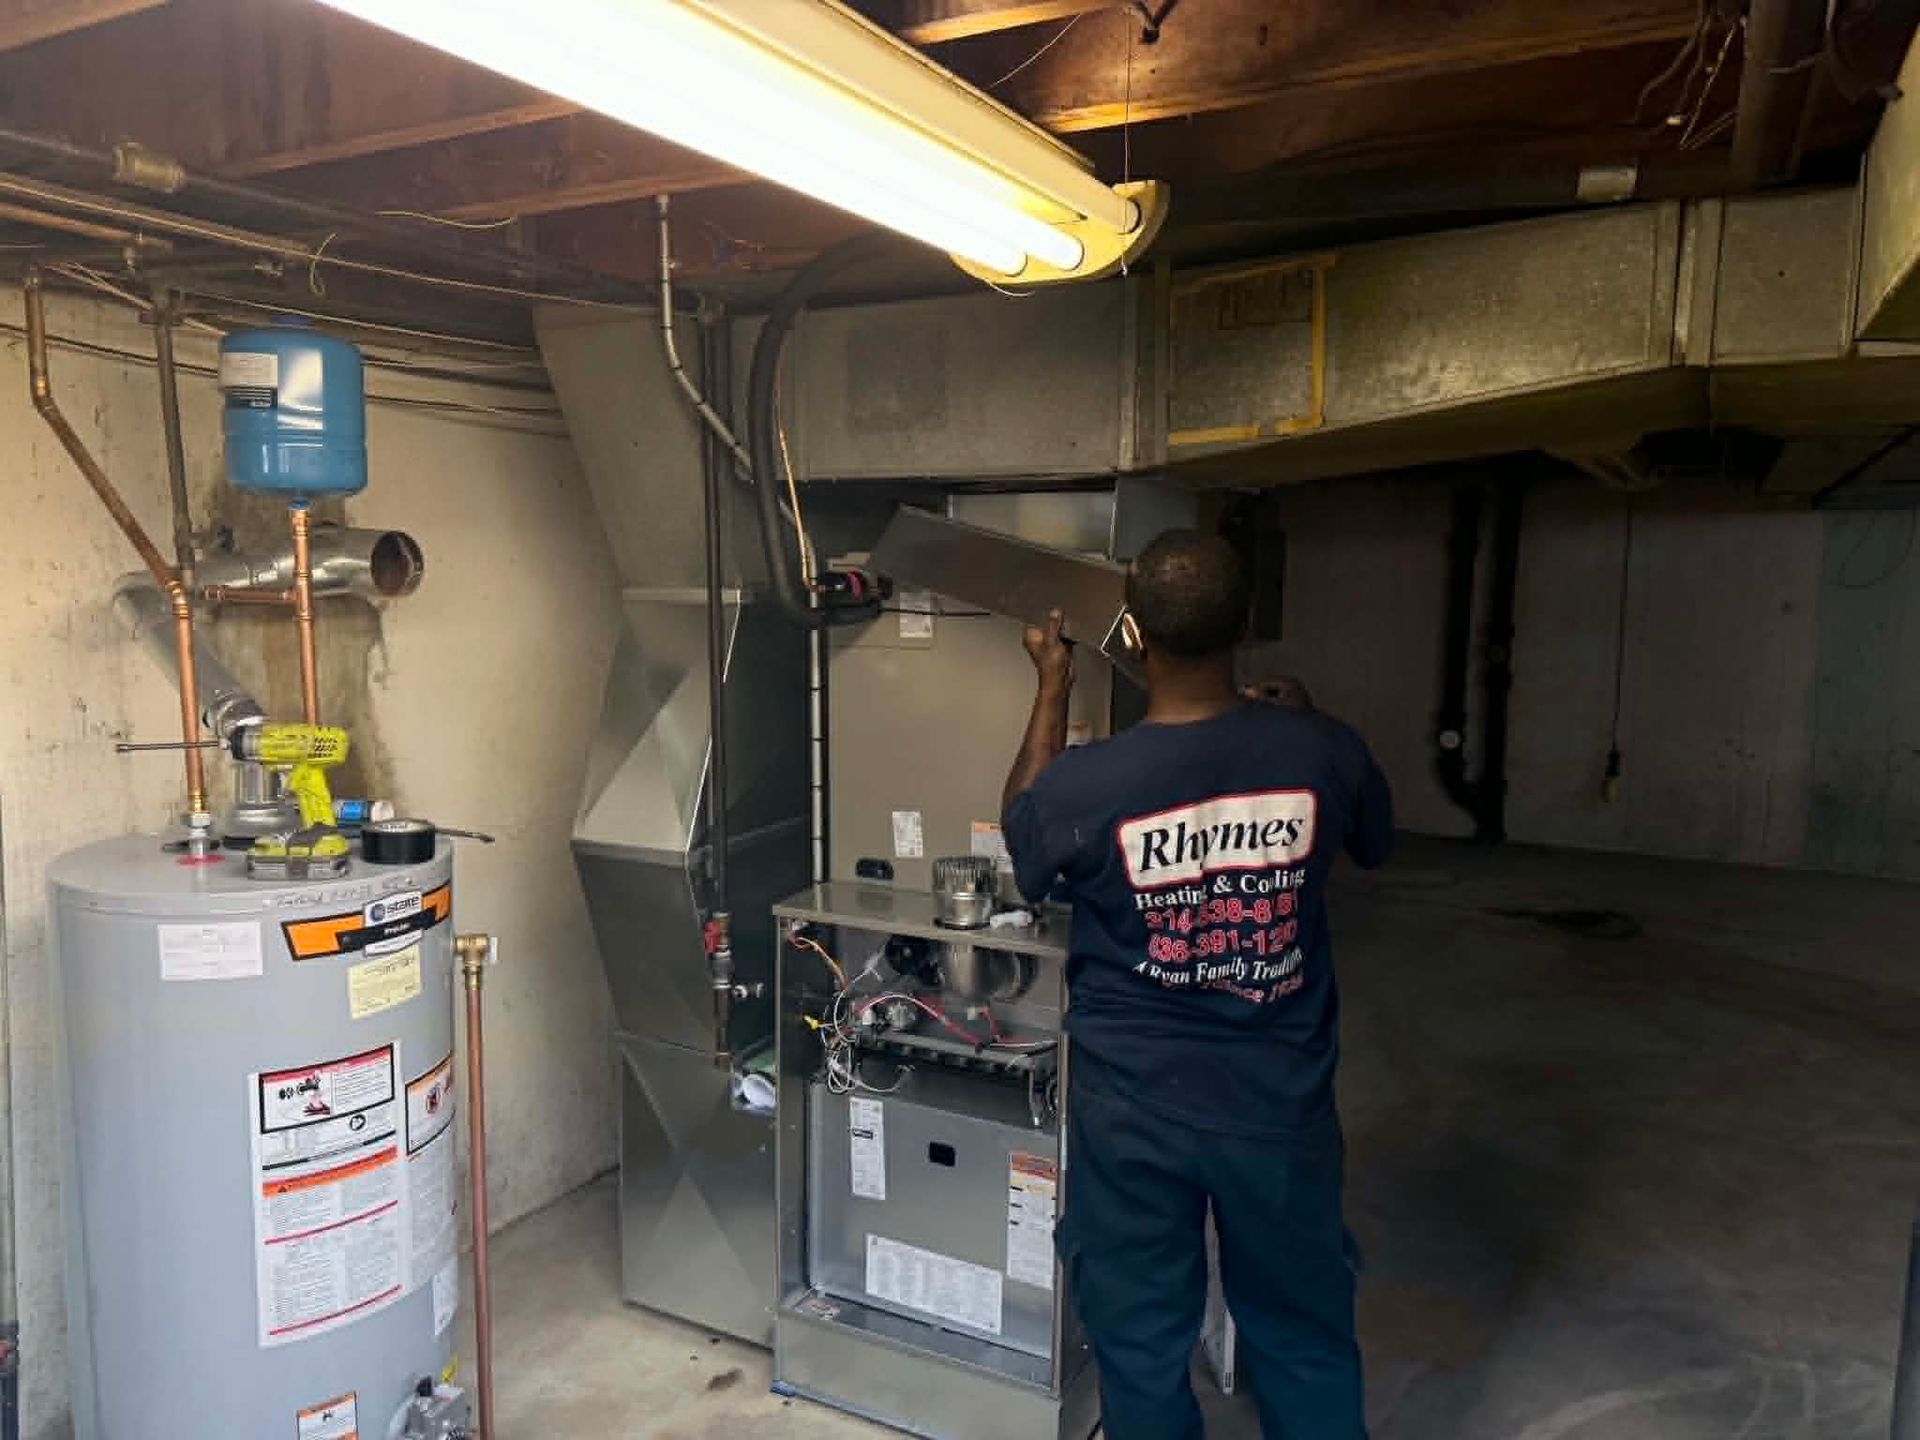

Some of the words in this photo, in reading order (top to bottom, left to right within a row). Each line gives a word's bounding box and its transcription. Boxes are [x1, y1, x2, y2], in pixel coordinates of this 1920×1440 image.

[1139, 816, 1303, 873] Rhymes
[1213, 874, 1234, 894] &
[1240, 868, 1306, 894] Coling
[1195, 957, 1248, 982] Family
